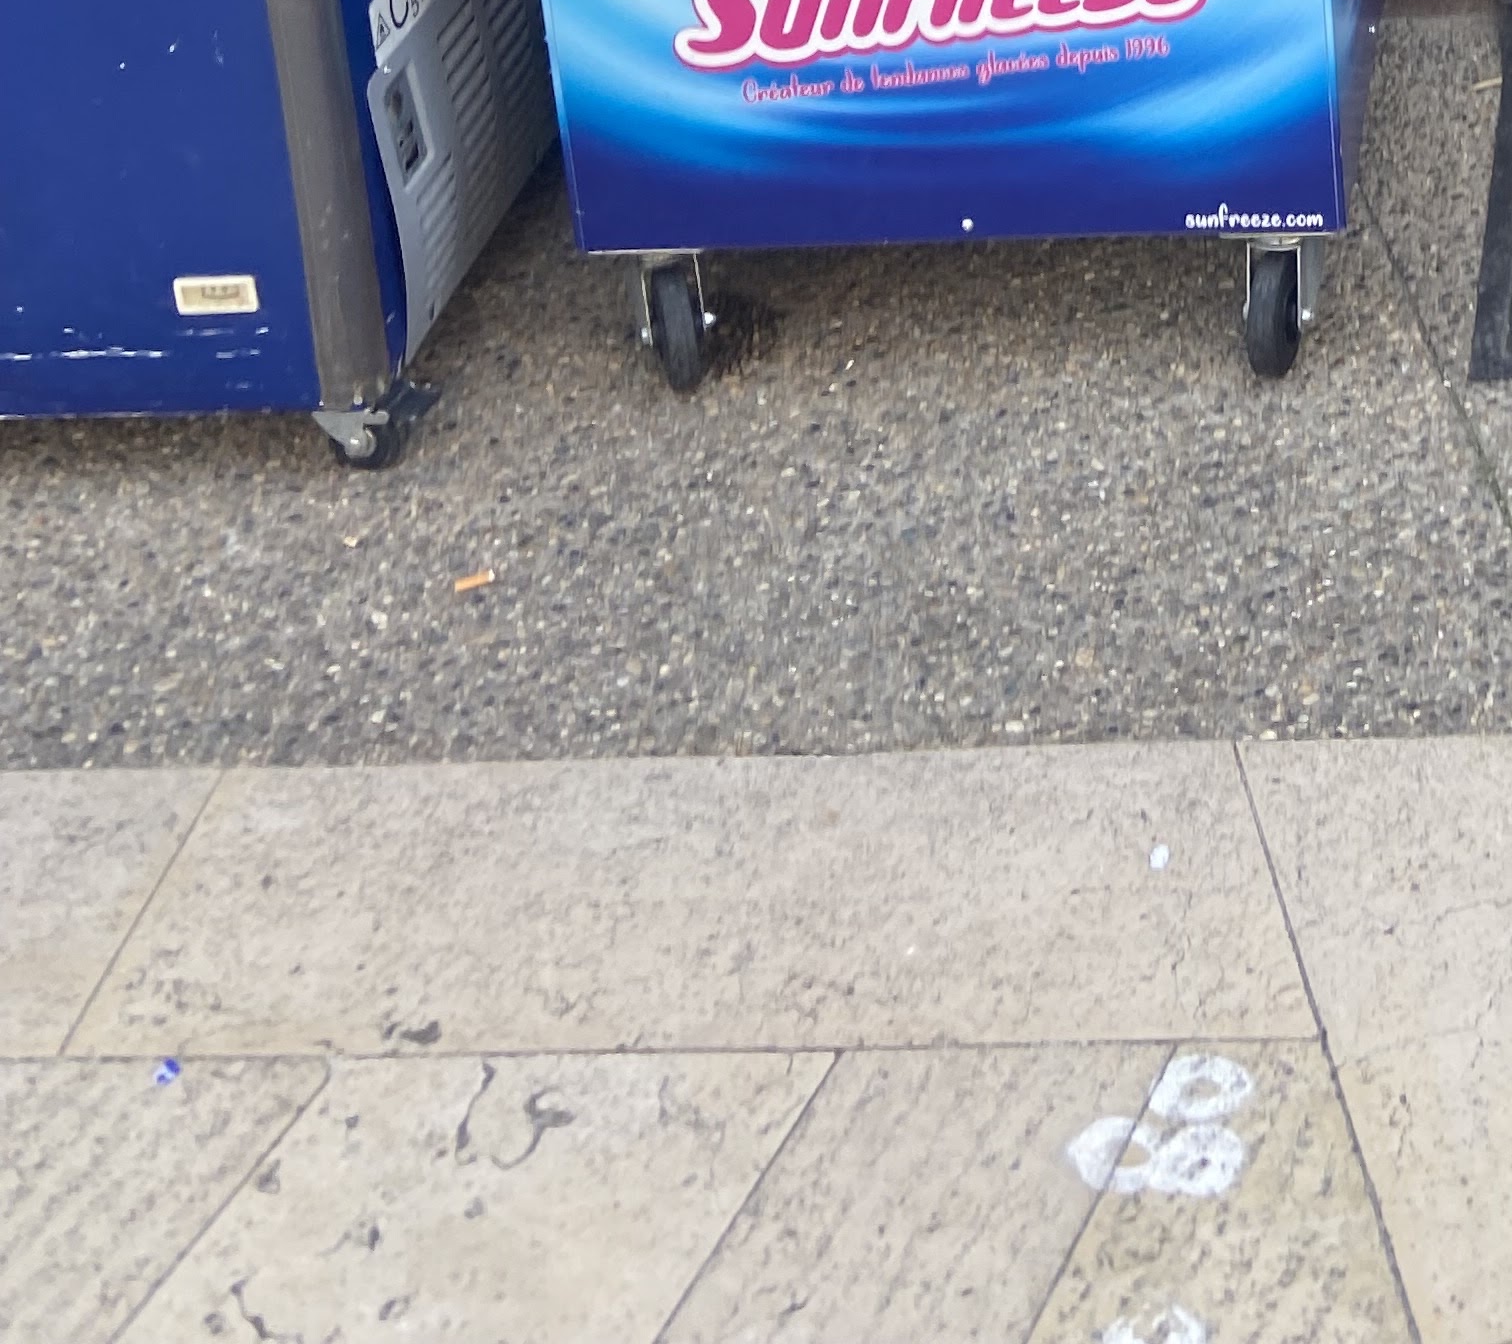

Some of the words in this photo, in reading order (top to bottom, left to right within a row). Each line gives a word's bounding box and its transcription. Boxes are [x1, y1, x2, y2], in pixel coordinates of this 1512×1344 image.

[742, 73, 834, 105] Créateur
[840, 69, 865, 95] de
[1056, 43, 1119, 76] depuis
[1124, 34, 1170, 60] 1996
[1185, 203, 1324, 229] sunfreeze.com
